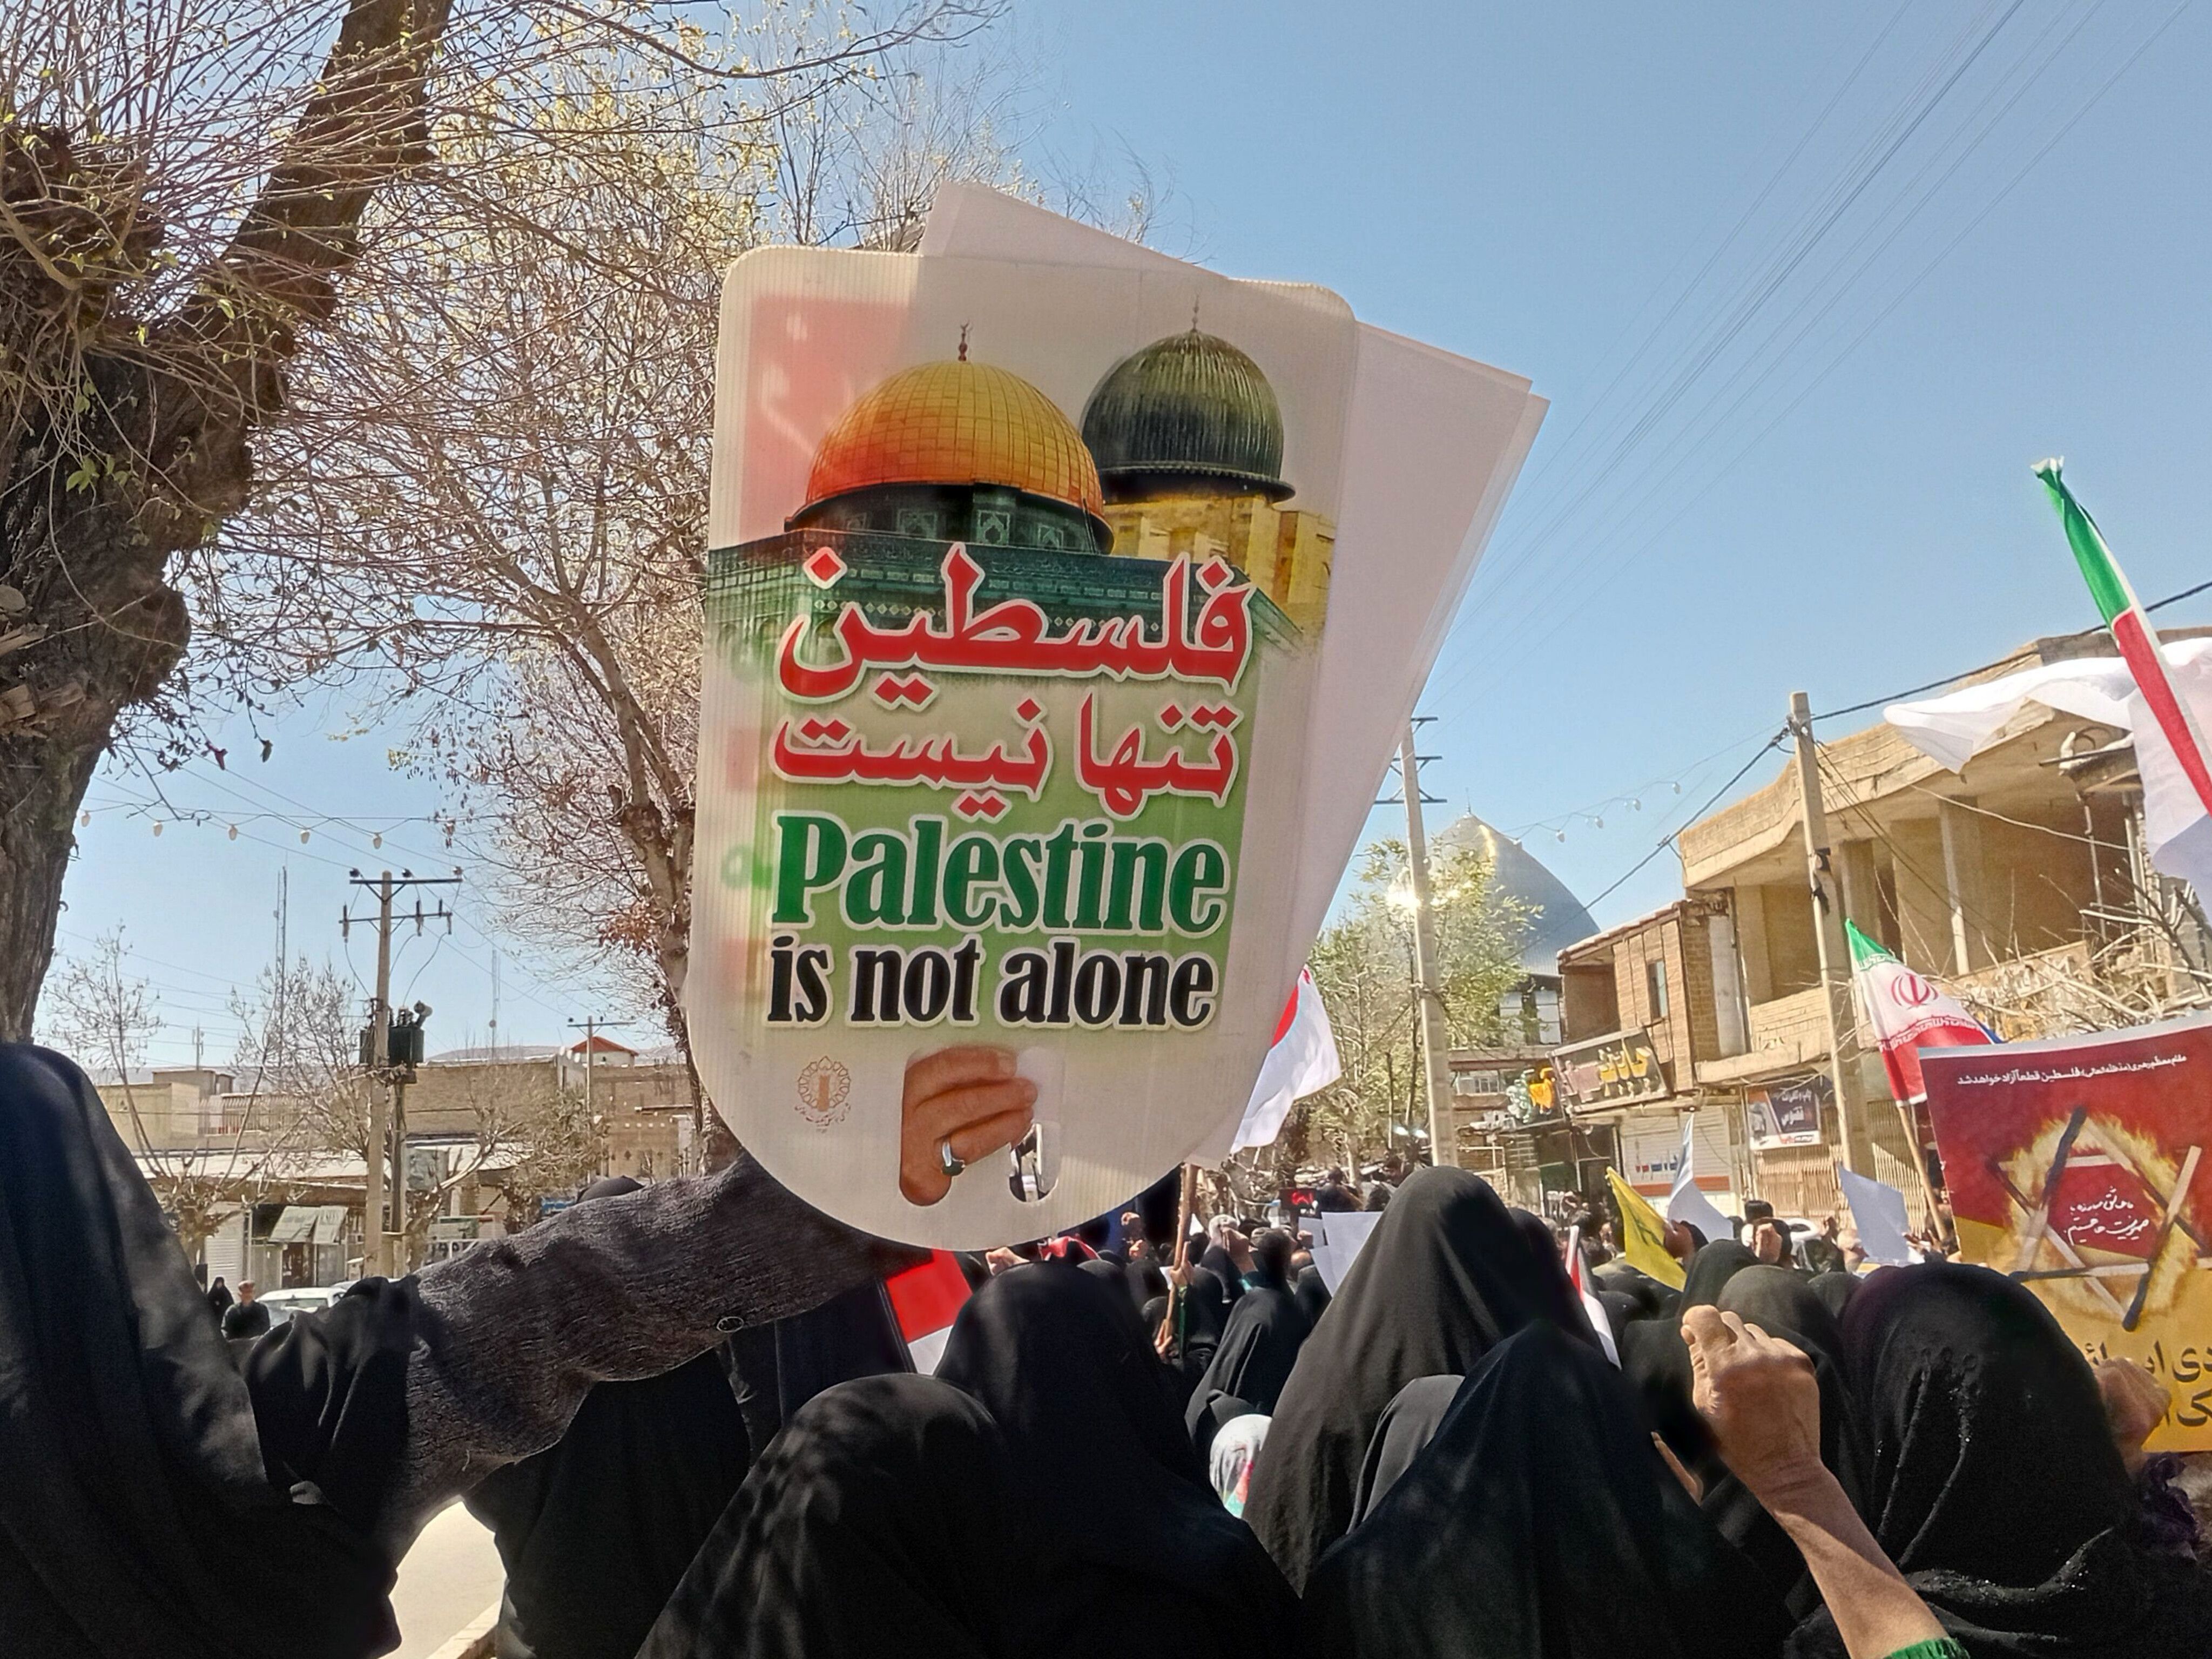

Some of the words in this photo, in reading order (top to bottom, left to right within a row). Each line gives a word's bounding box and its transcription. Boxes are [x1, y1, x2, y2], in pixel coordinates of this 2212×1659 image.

[777, 543, 1253, 706] فلسطین
[770, 697, 1051, 822] نیست
[1077, 691, 1242, 819] تنها
[772, 813, 1229, 934] Palestine
[767, 935, 831, 1025] is
[850, 939, 982, 1026] not
[999, 942, 1217, 1029] alone
[2041, 1066, 2081, 1082] فلسطین
